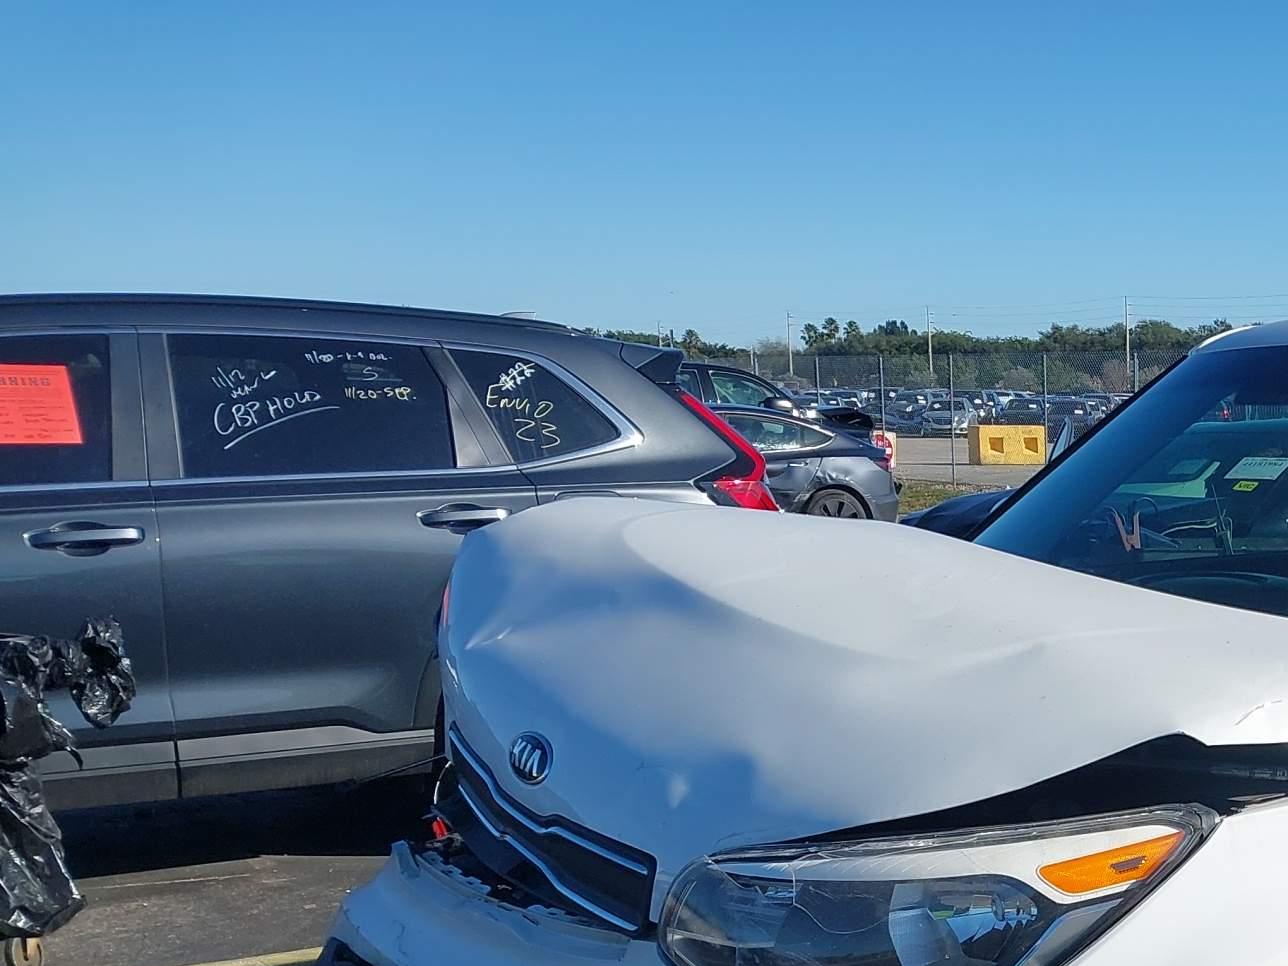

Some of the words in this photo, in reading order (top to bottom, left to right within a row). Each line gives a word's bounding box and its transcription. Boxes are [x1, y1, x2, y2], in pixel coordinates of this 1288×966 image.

[213, 401, 260, 436] CBP
[514, 418, 561, 449] 23
[512, 737, 542, 777] KIA
